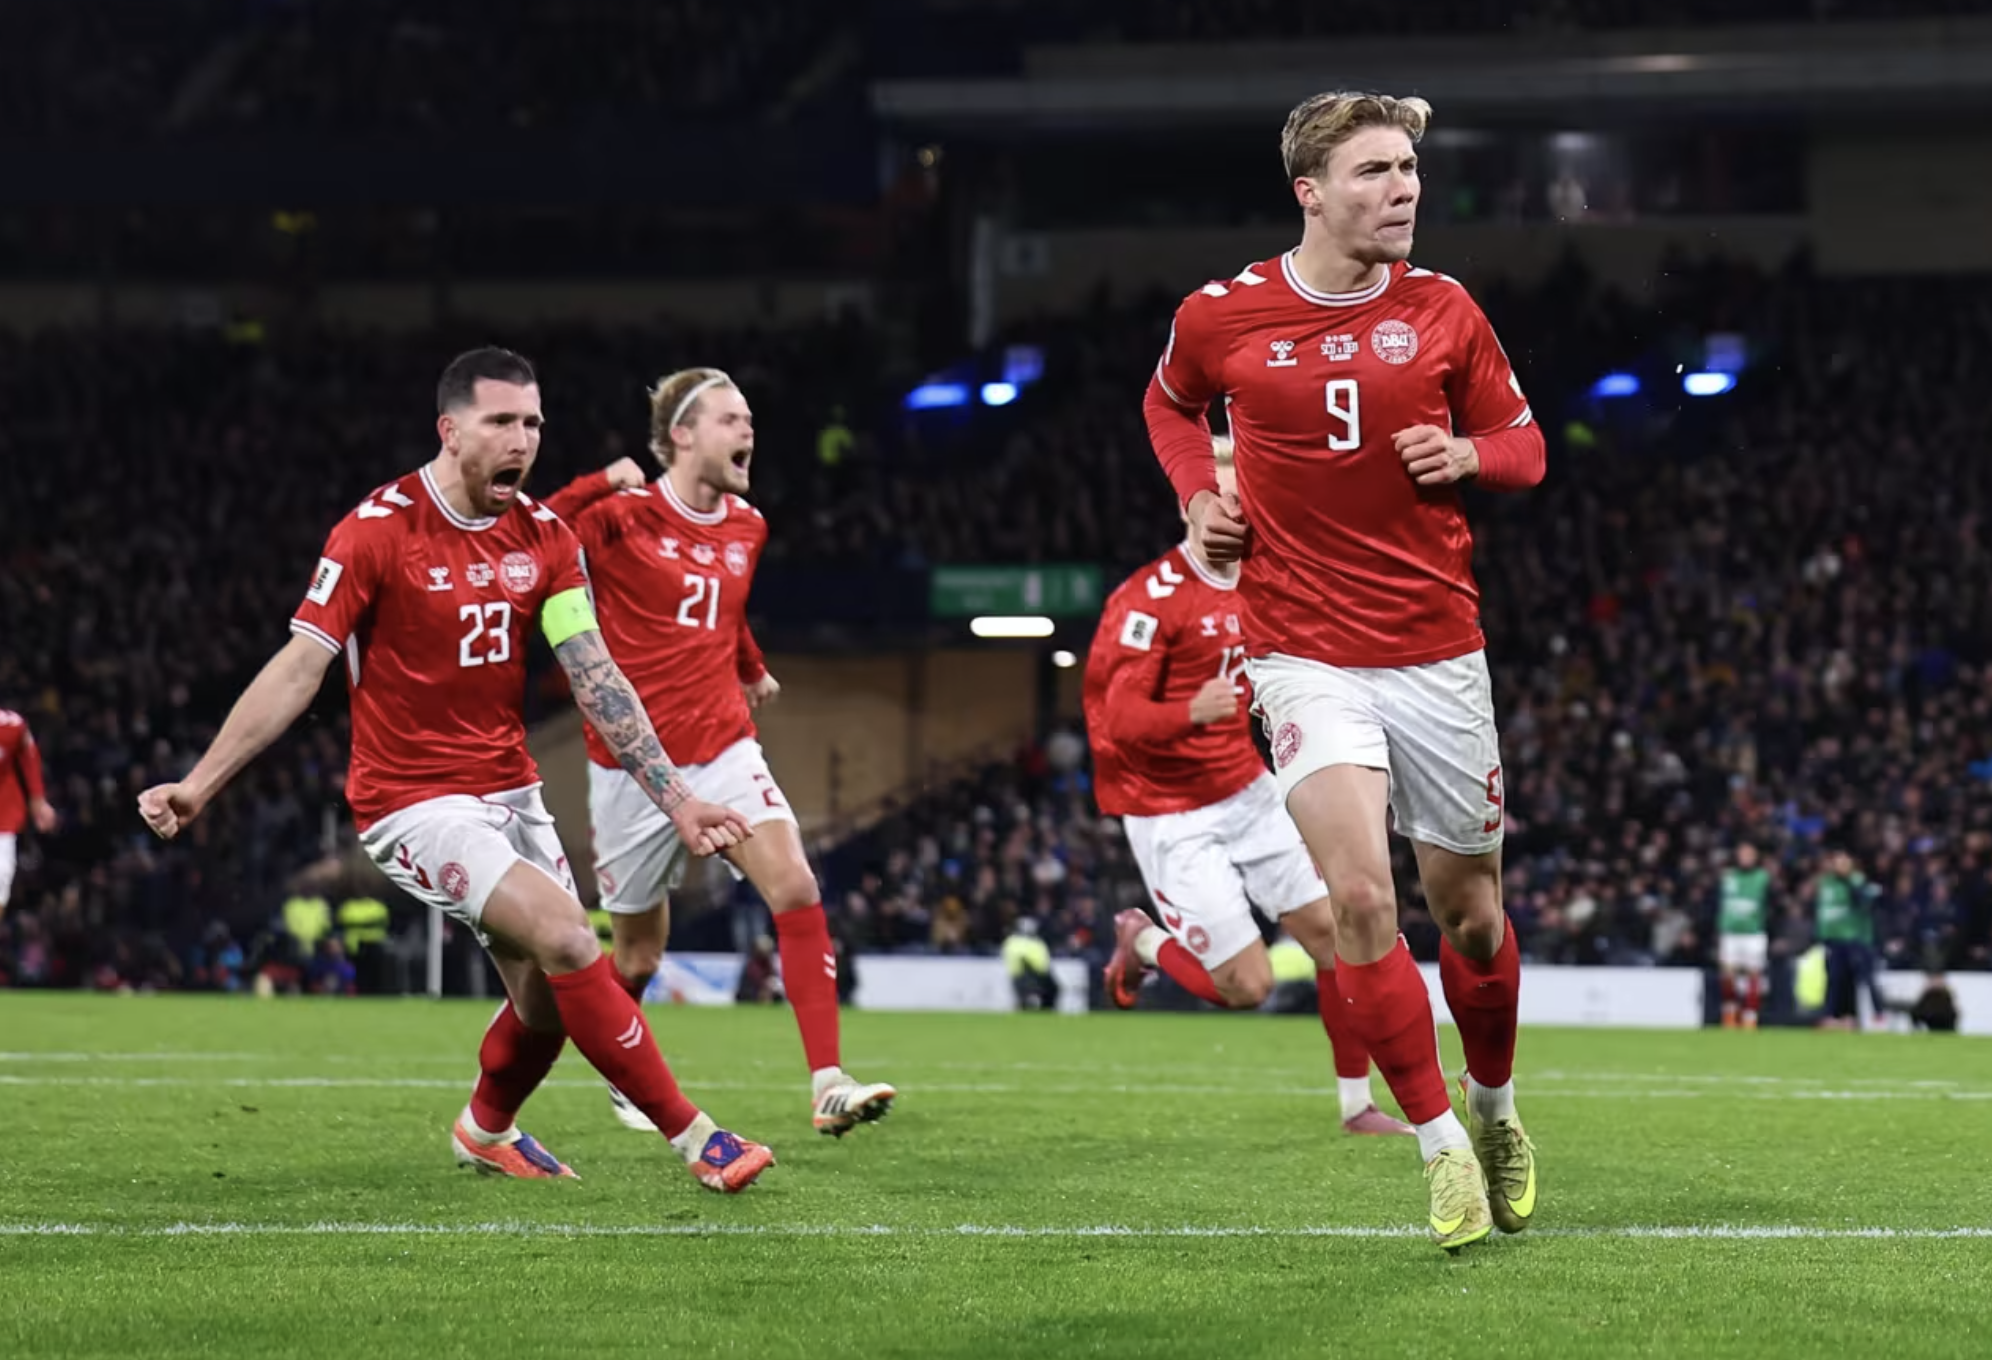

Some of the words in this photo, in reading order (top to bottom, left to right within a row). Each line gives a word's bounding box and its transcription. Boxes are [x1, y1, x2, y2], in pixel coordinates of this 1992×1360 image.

[1382, 334, 1409, 347] DBU
[1325, 379, 1361, 450] 9
[677, 573, 720, 630] 21
[459, 601, 511, 667] 23
